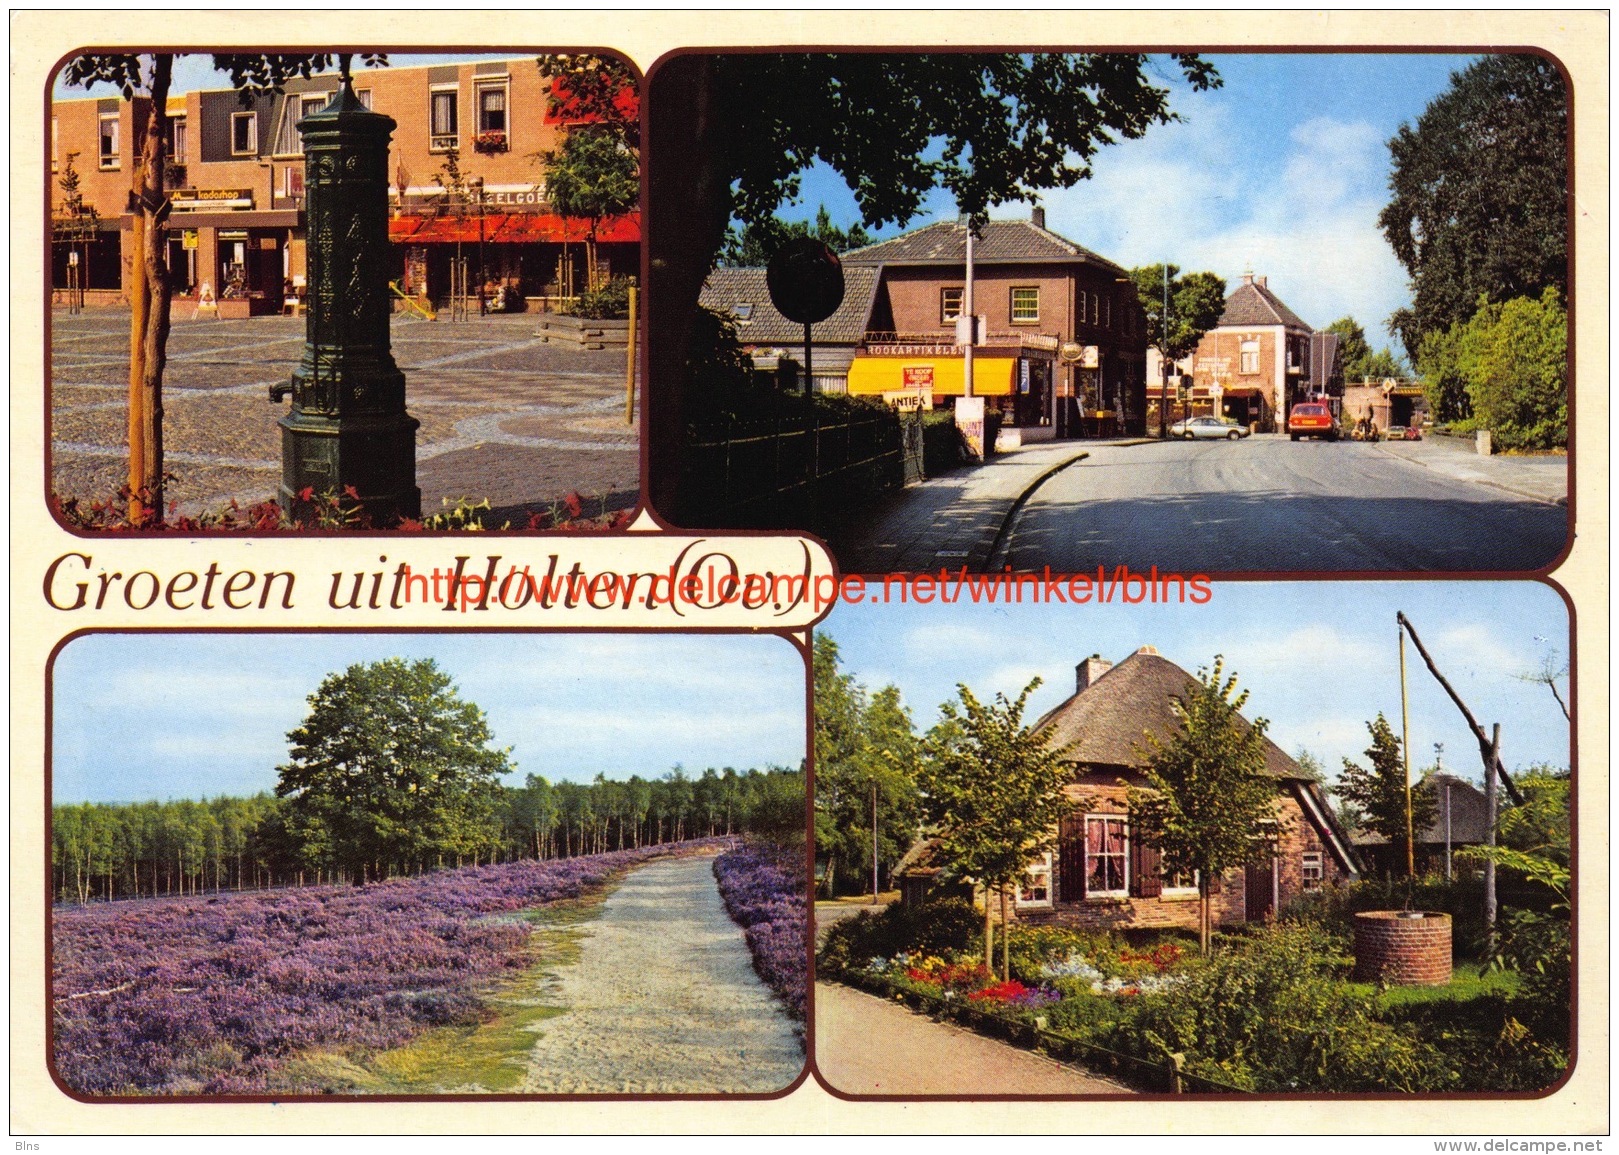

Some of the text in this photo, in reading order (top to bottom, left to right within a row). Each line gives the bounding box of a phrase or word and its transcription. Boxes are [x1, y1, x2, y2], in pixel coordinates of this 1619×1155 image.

[198, 191, 239, 199] kadoshop
[466, 192, 555, 204] SEELGOE
[867, 345, 965, 355] ROOKARTIKELEN
[891, 396, 926, 407] ANTIEK
[42, 552, 296, 611] Groeten
[328, 555, 411, 610] uit
